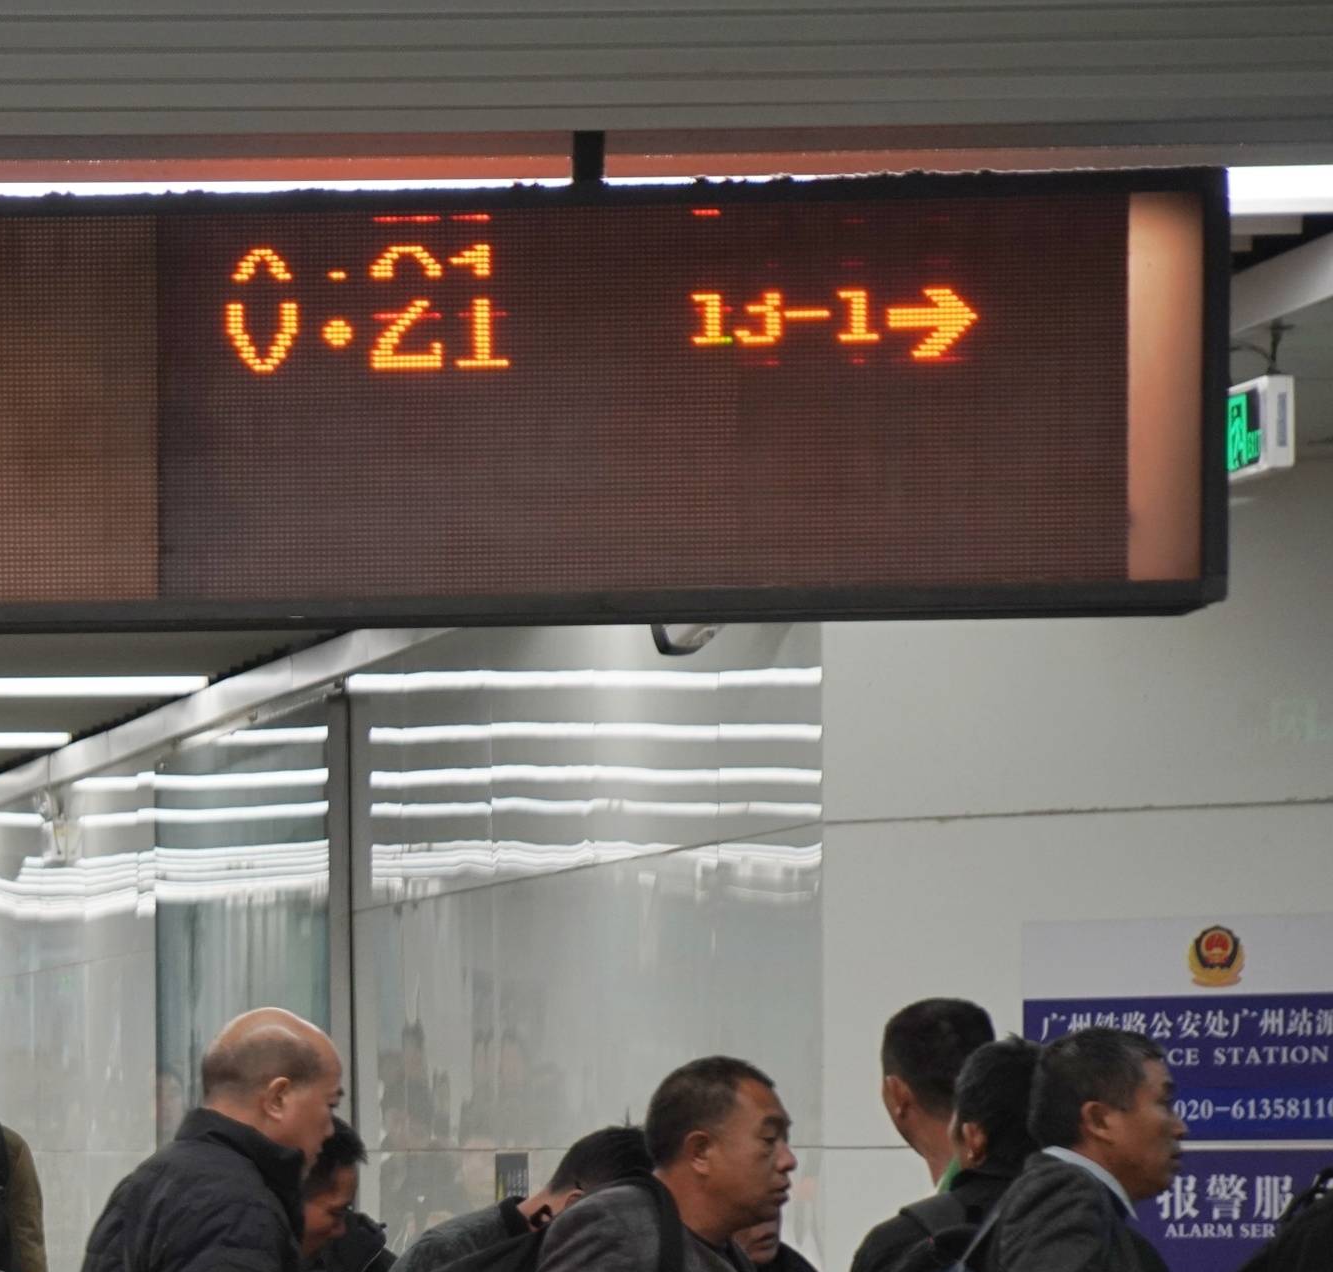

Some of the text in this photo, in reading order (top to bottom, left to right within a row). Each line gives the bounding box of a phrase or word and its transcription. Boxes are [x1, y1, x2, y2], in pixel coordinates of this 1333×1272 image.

[1162, 1045, 1330, 1066] CE STATION
[1155, 1173, 1321, 1222] 报警服
[1165, 1221, 1278, 1239] ALARM SER
